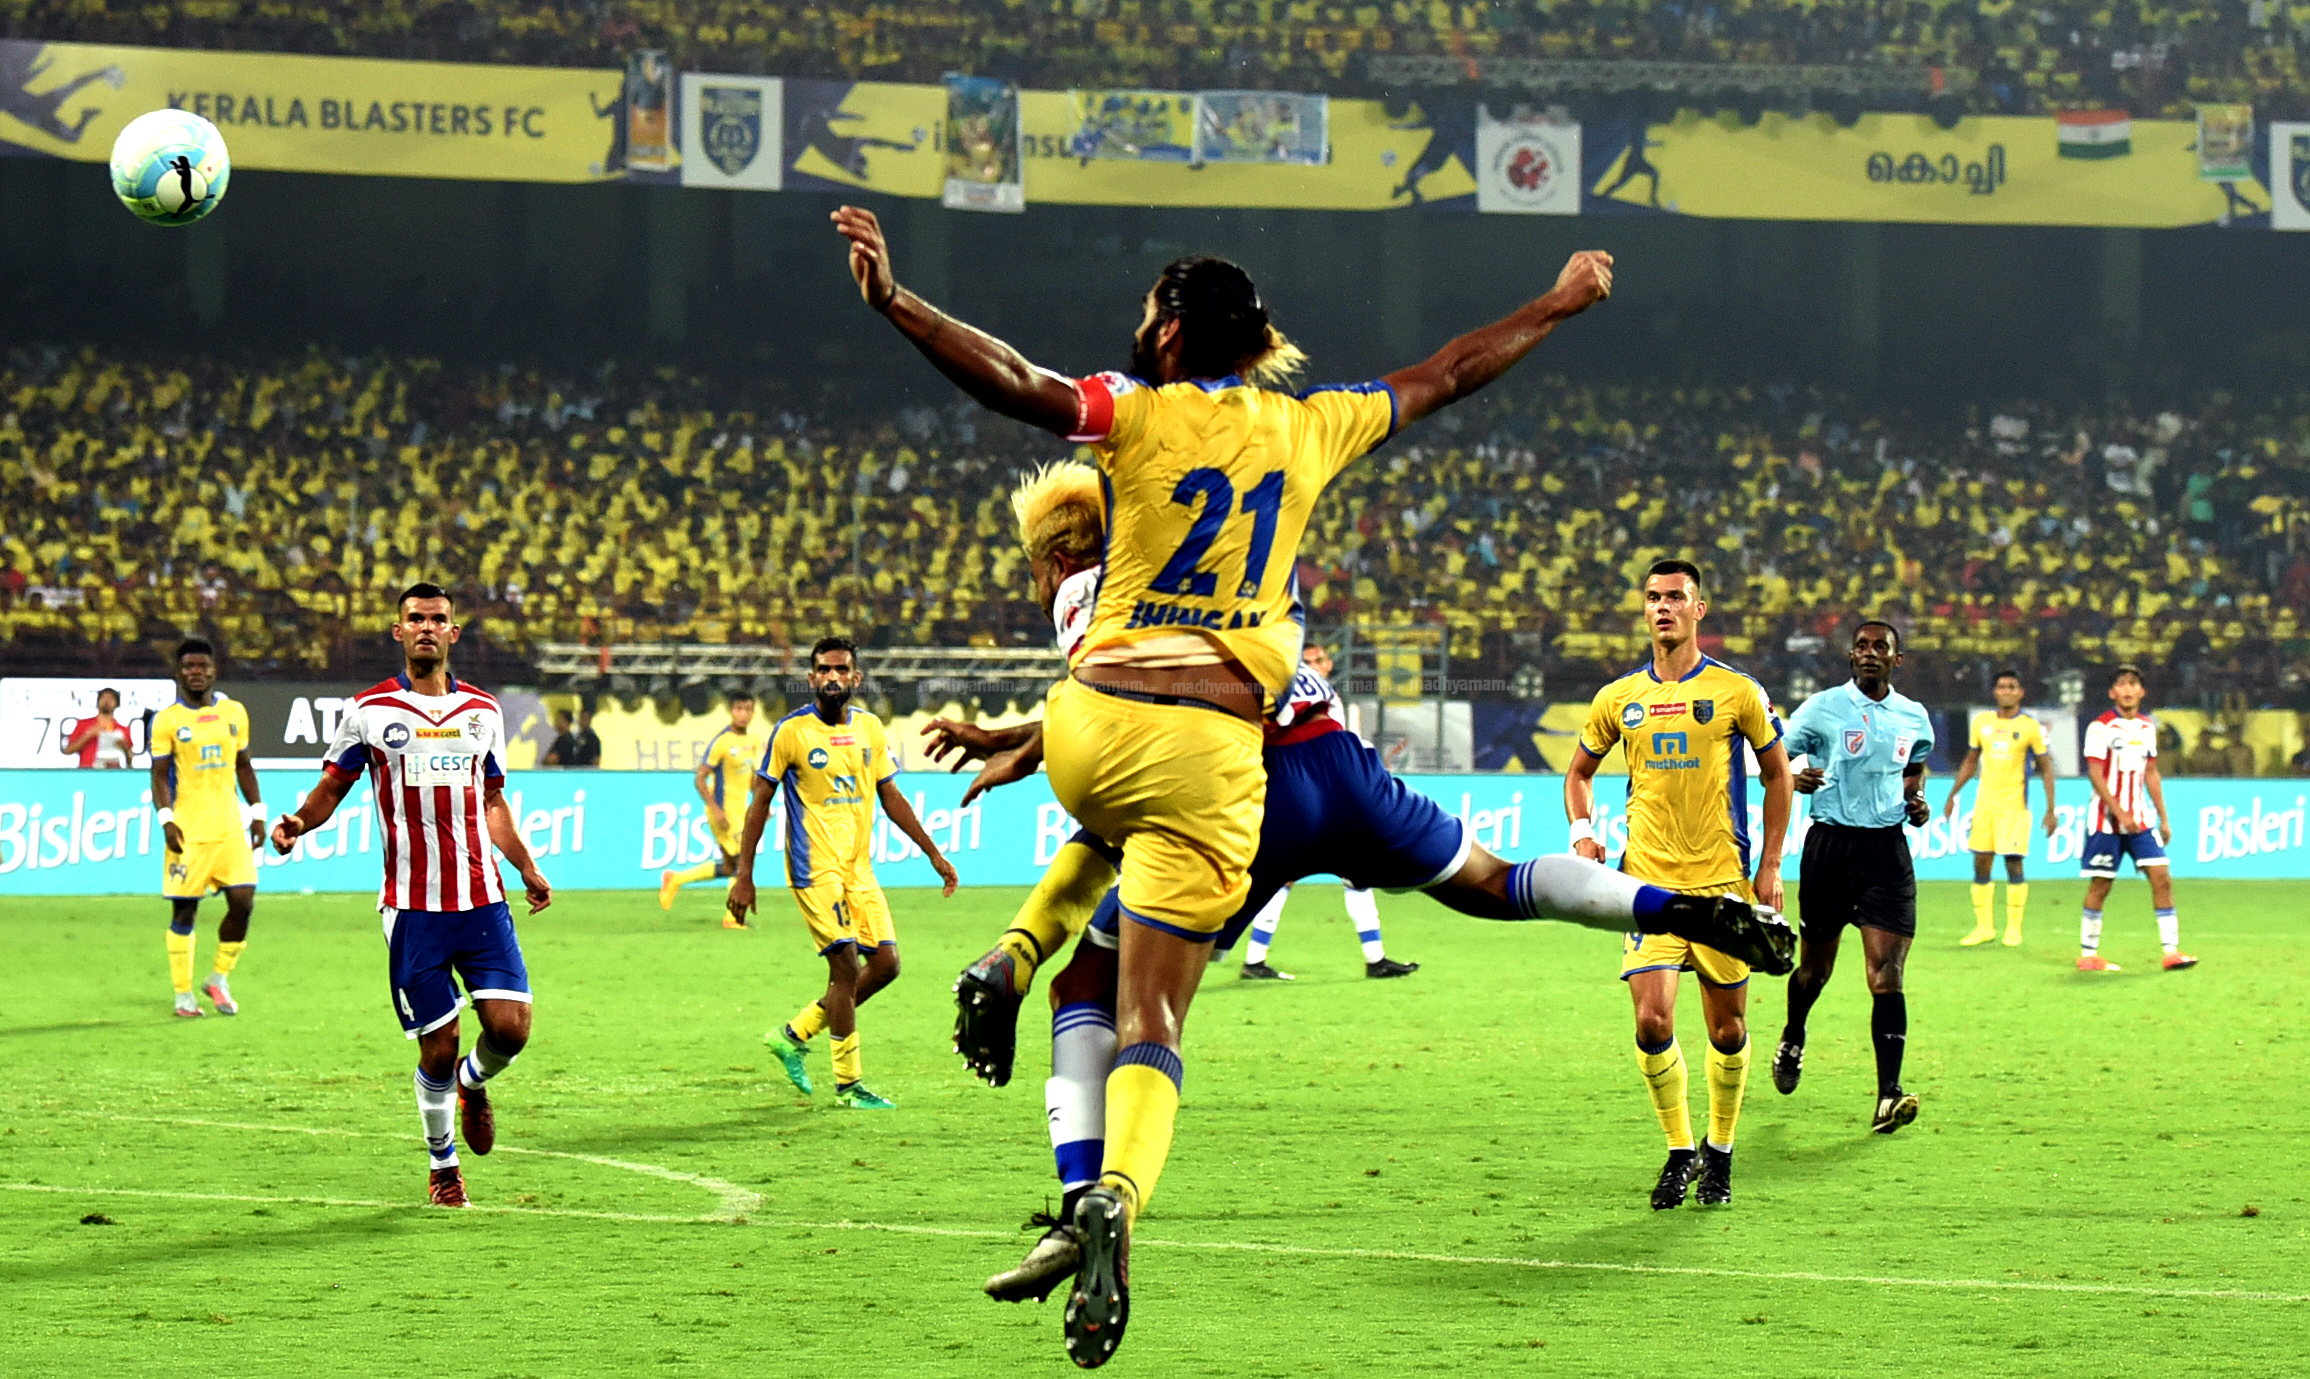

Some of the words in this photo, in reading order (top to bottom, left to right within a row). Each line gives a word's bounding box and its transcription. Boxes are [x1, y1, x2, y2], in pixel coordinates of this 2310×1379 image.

[166, 91, 309, 129] KERALA
[320, 98, 493, 137] BLASTERS
[504, 106, 546, 139] FC
[1147, 467, 1286, 599] 21
[284, 698, 358, 744] AT
[385, 728, 408, 742] Jio
[1623, 708, 1643, 722] Jio
[429, 755, 471, 771] CESC
[1645, 757, 1700, 770] muthoot
[0, 789, 154, 876] Bisleri
[870, 790, 983, 864] isleri
[2196, 795, 2306, 864] Bisleri
[398, 987, 416, 1022] 4
